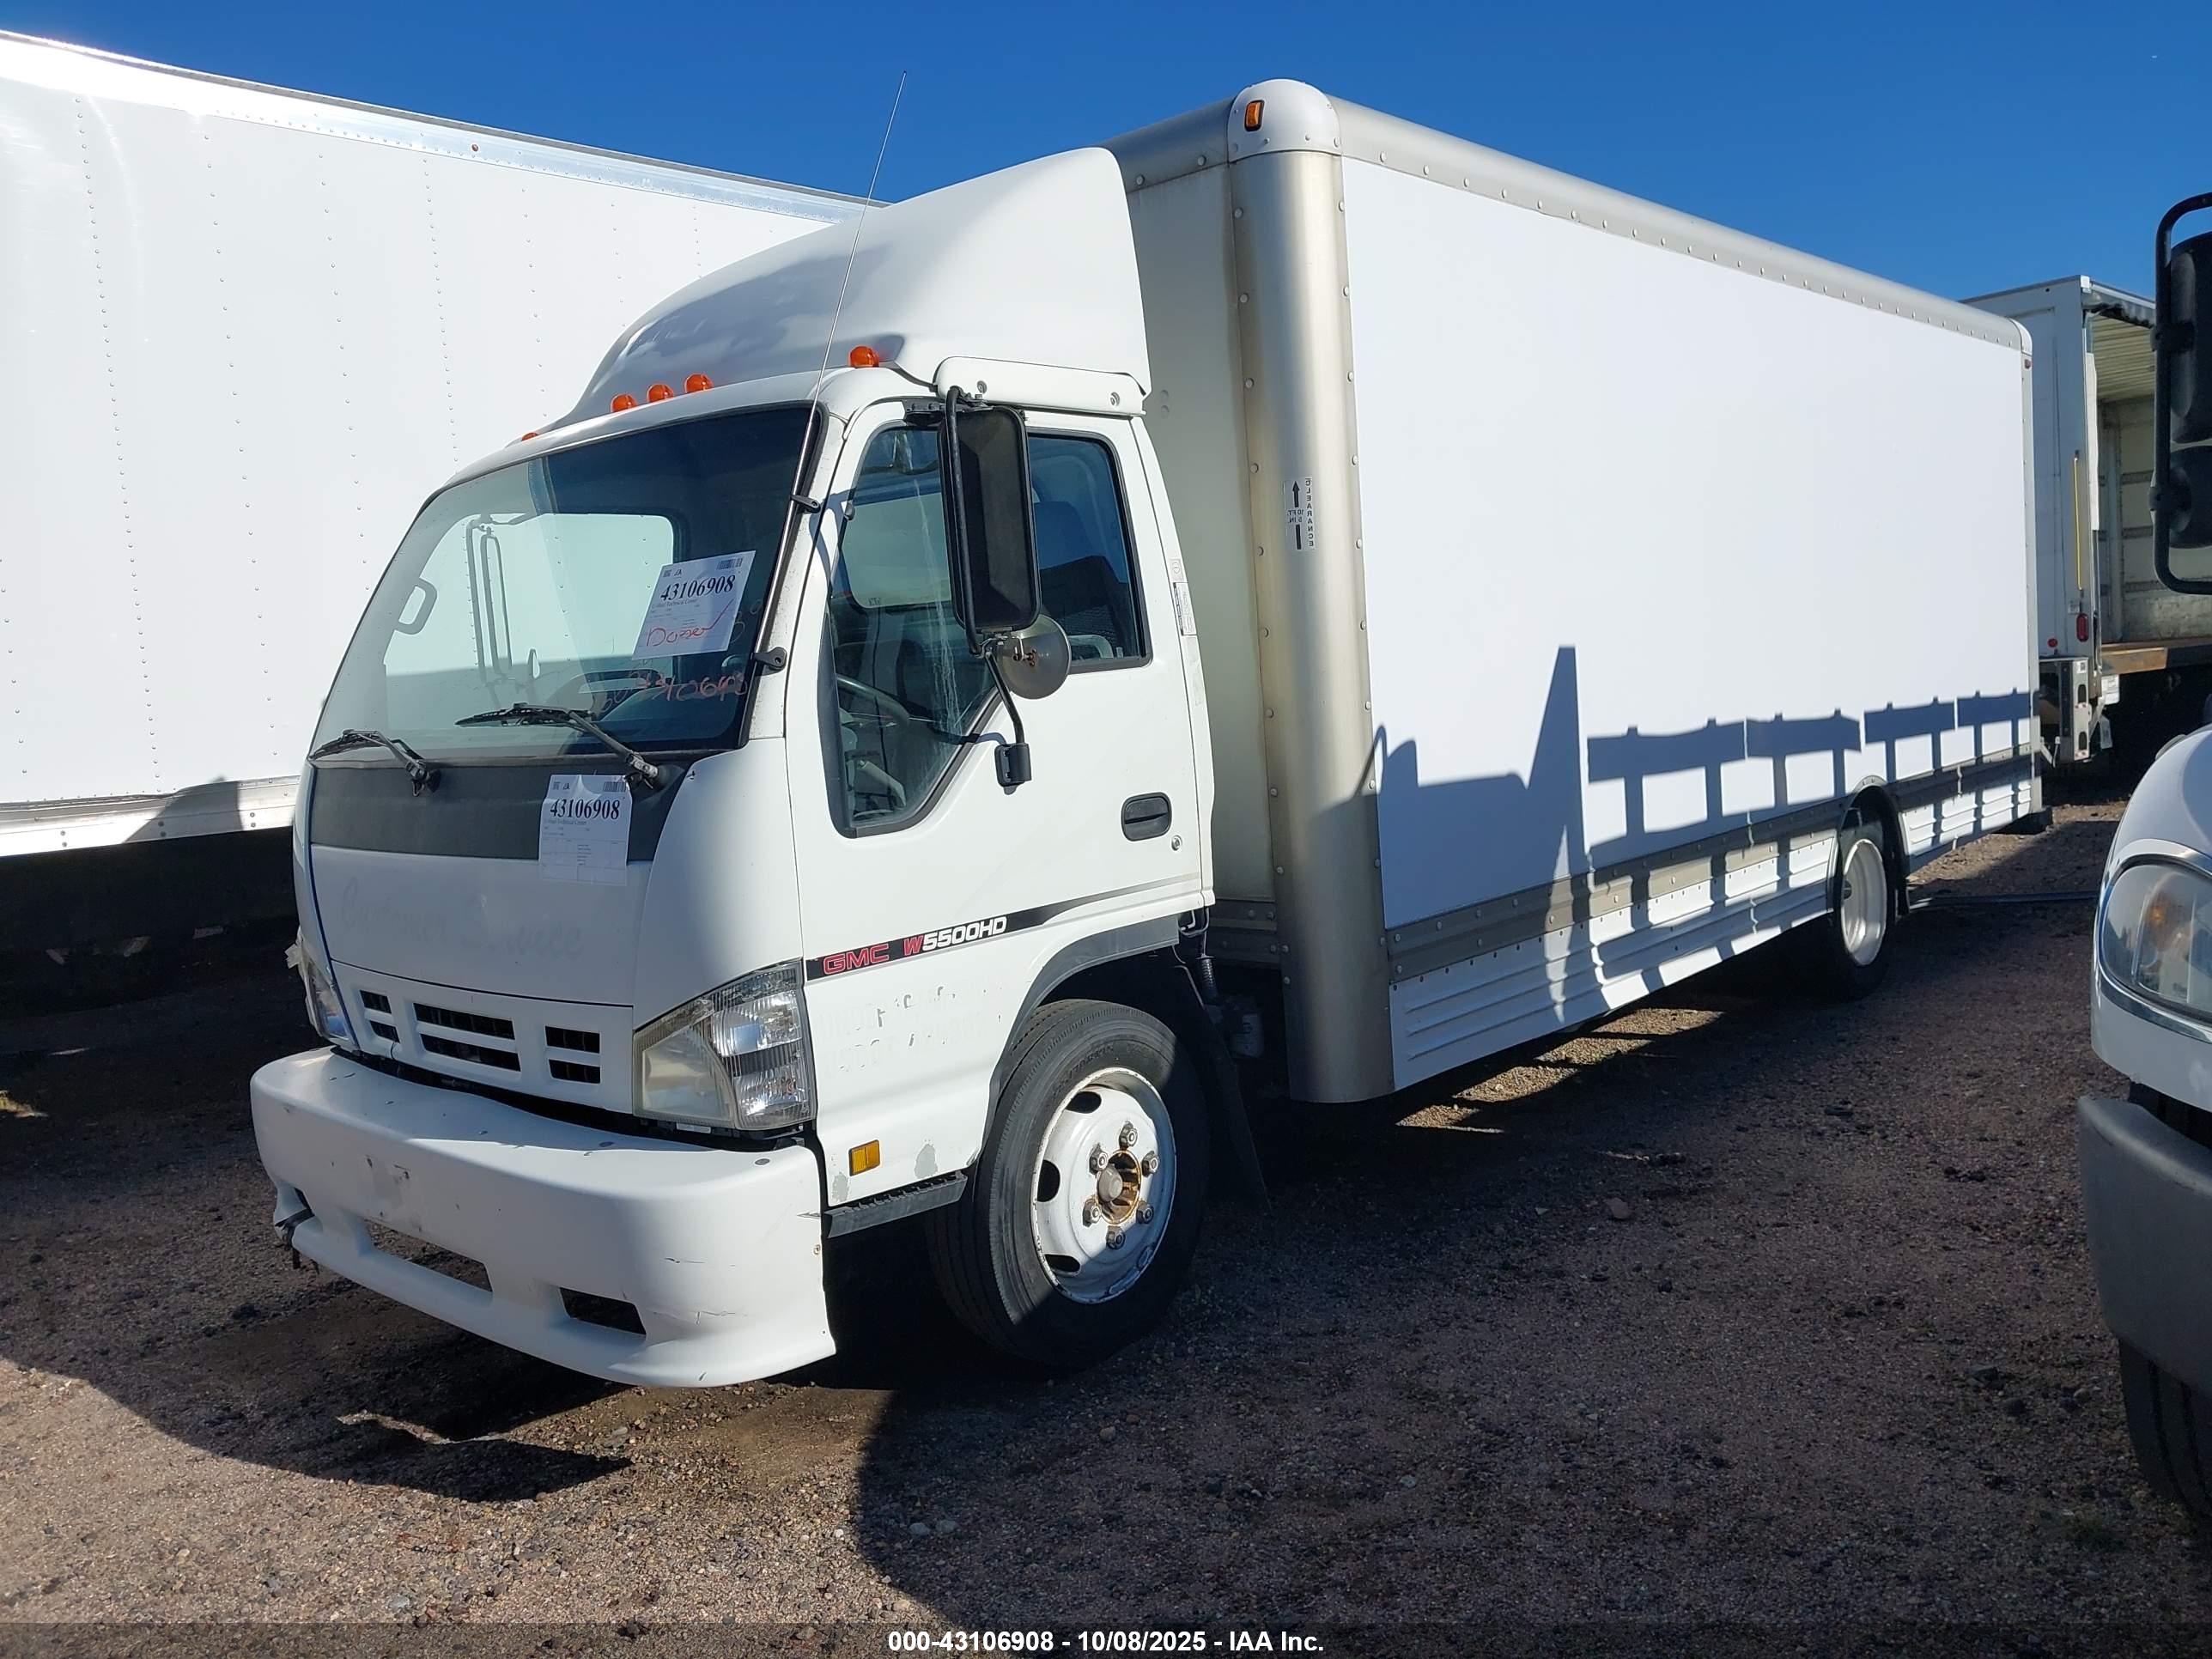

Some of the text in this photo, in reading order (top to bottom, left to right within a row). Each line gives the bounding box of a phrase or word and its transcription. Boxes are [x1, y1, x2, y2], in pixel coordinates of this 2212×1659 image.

[660, 574, 735, 601] 43106908
[550, 798, 621, 820] 43106908
[823, 915, 1007, 975] GMC W5500HD
